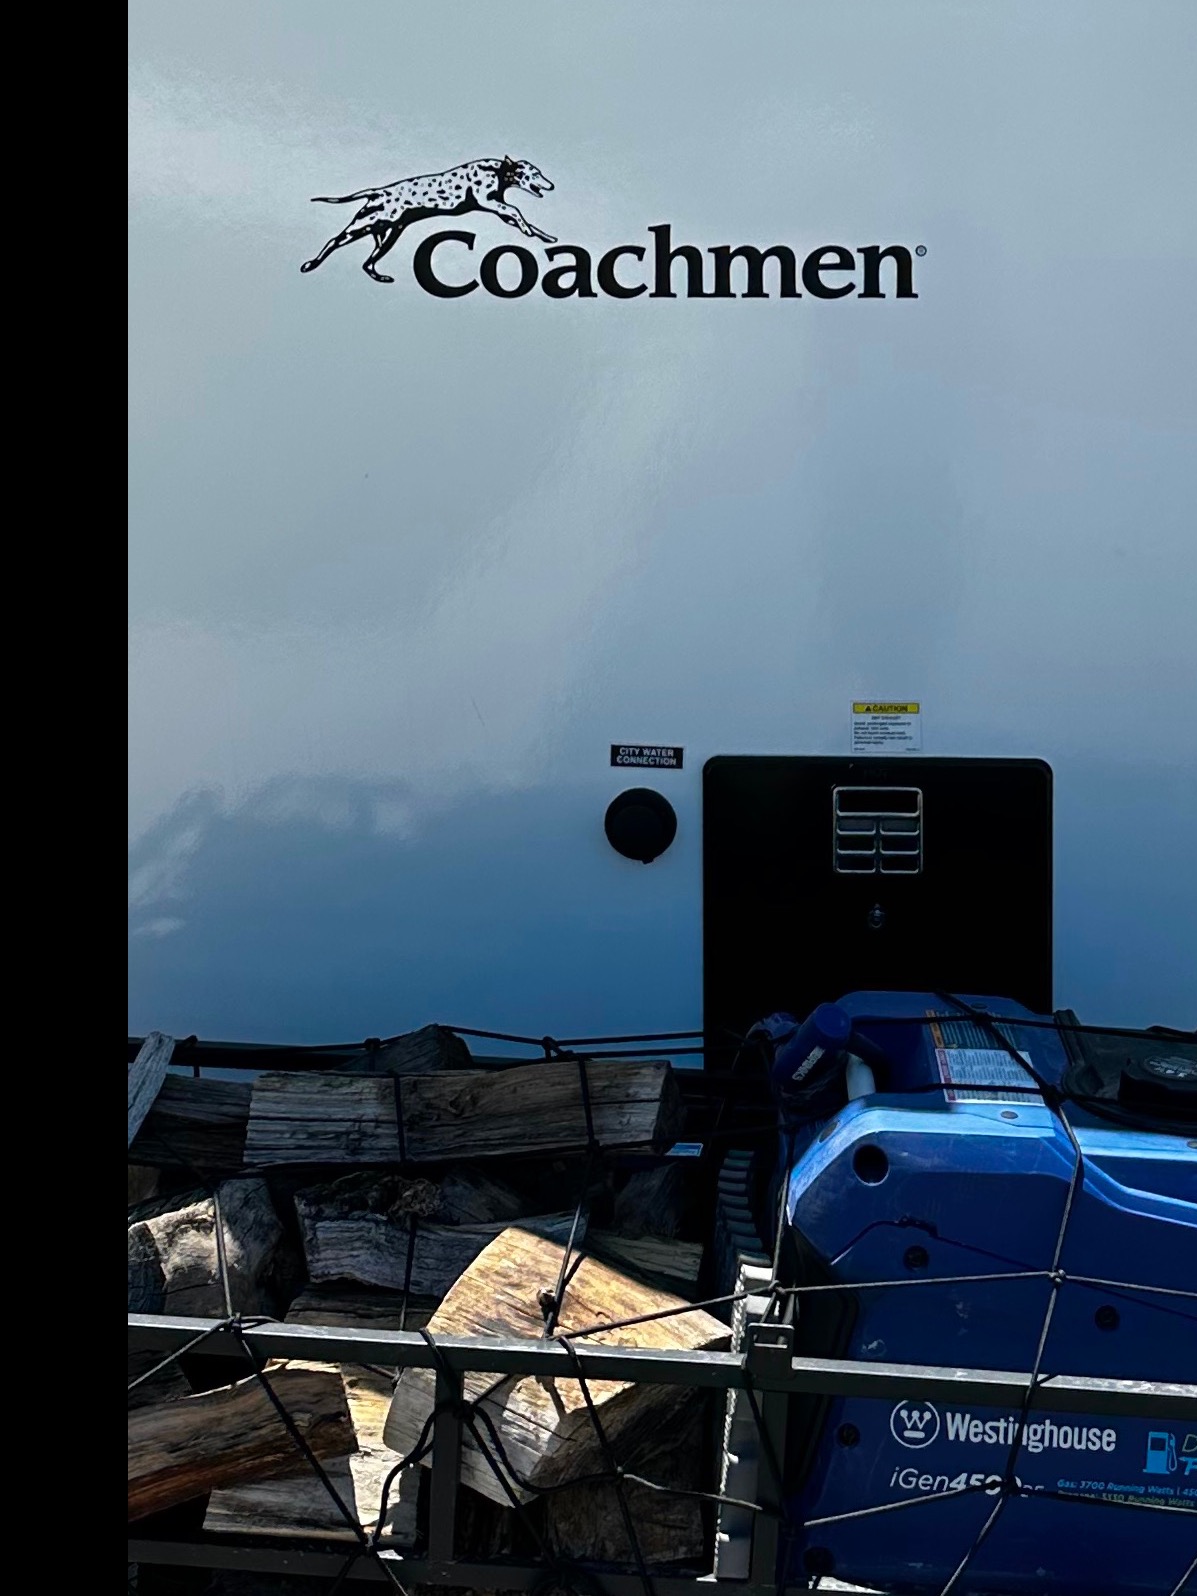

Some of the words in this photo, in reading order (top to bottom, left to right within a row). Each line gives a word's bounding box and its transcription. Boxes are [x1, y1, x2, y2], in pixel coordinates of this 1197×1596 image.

[872, 705, 908, 713] CAUTION
[619, 747, 640, 756] CITY
[642, 748, 674, 757] WATER
[616, 756, 677, 766] CONNECTION
[945, 1411, 1117, 1453] Westinghouse
[1079, 1480, 1106, 1490] 3700
[1106, 1481, 1145, 1494] Running
[1147, 1485, 1174, 1495] Watts
